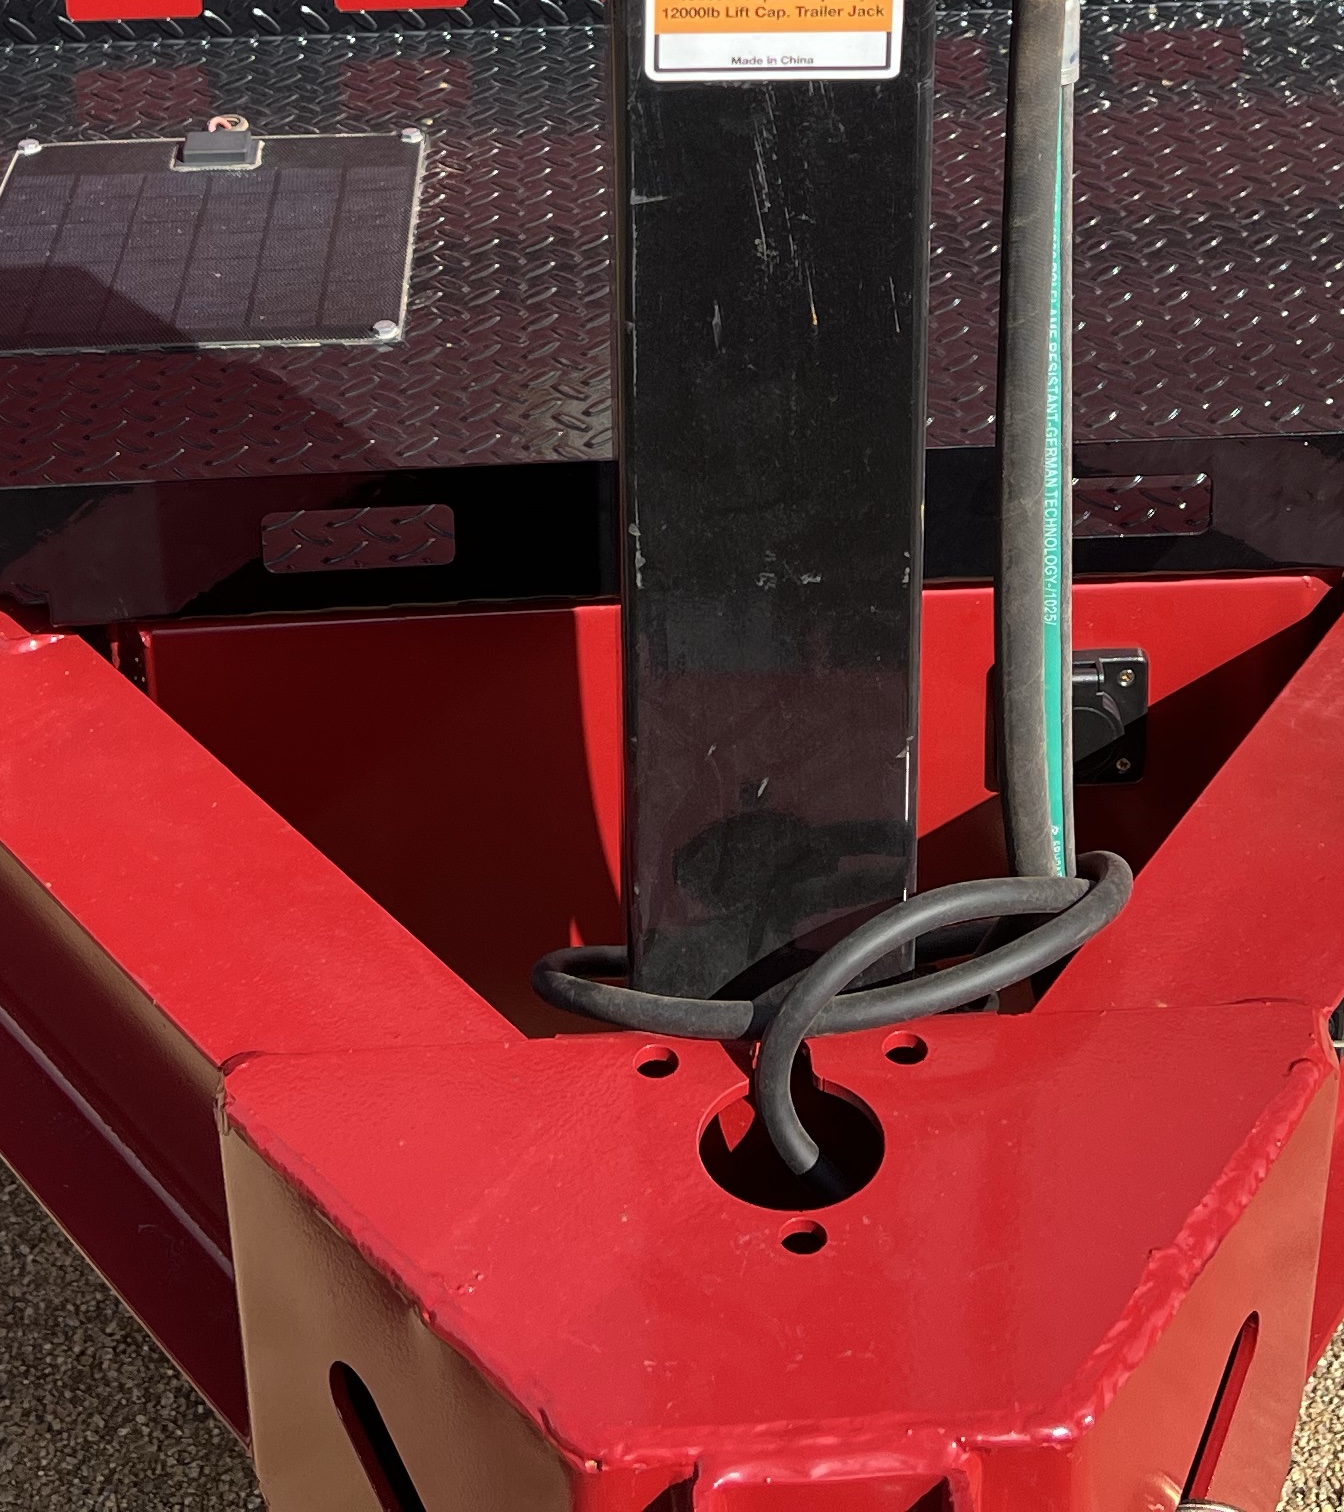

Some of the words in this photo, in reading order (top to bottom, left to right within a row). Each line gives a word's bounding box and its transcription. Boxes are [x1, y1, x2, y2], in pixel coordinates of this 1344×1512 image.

[662, 6, 720, 20] 12000lb
[725, 6, 750, 19] Lift
[755, 6, 791, 21] Cap.
[797, 5, 844, 19] Trailer
[848, 4, 885, 18] Jack
[730, 55, 763, 66] Made
[767, 55, 777, 65] in
[781, 54, 814, 65] China
